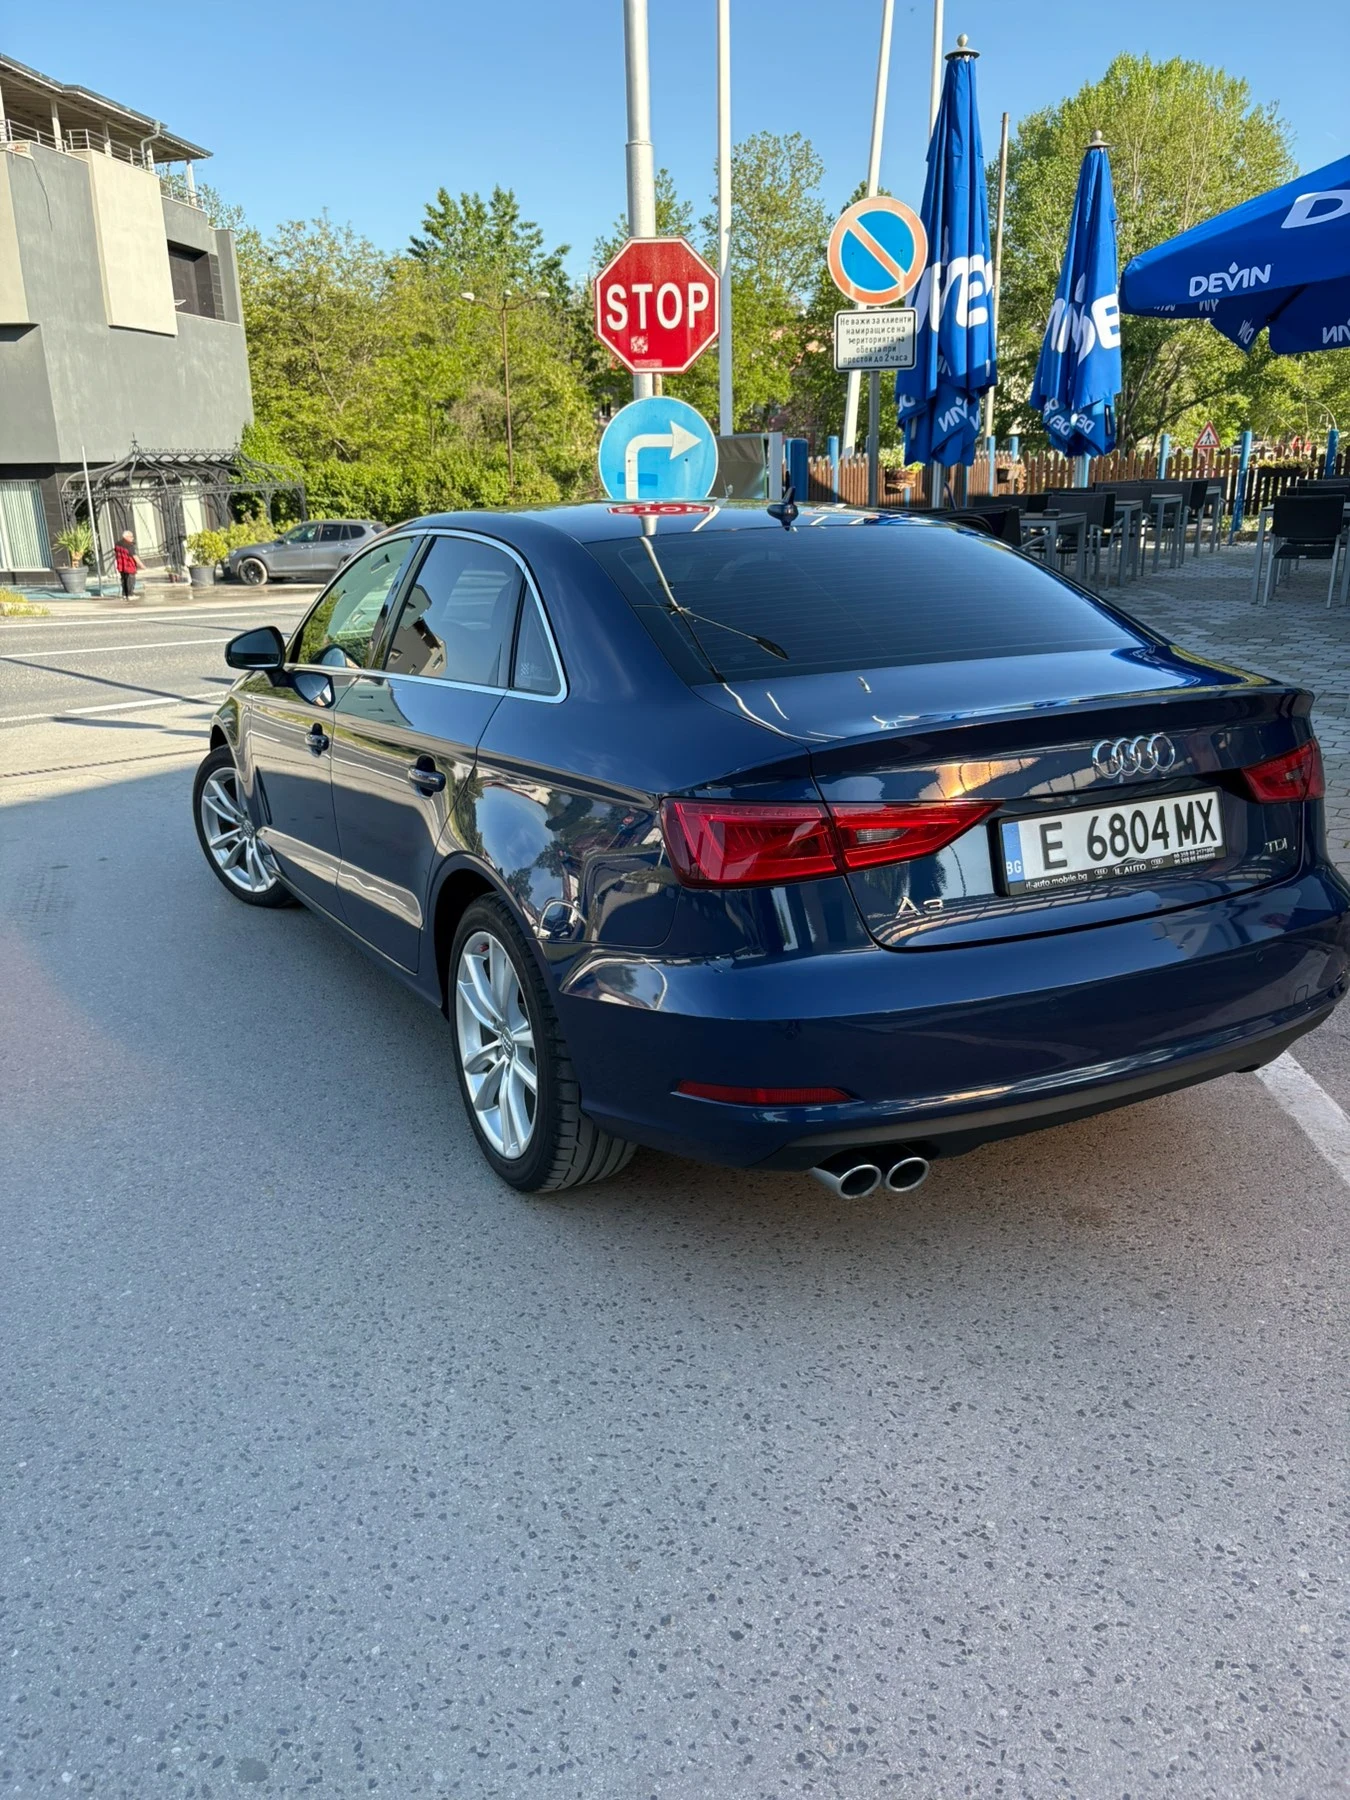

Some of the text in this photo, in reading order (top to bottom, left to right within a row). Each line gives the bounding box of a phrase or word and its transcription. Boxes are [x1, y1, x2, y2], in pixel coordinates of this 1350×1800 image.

[1188, 262, 1272, 297] DEVIN
[605, 281, 710, 331] STOP
[840, 316, 912, 326] Не важи за клиенти
[846, 327, 886, 336] намиращи
[896, 335, 905, 343] на
[882, 345, 897, 354] при
[874, 356, 884, 364] до
[885, 354, 891, 362] 2
[1039, 821, 1068, 871] E
[1265, 837, 1288, 853] TDI
[1006, 860, 1022, 875] BG
[1124, 863, 1147, 874] AUTO
[895, 896, 944, 919] A3
